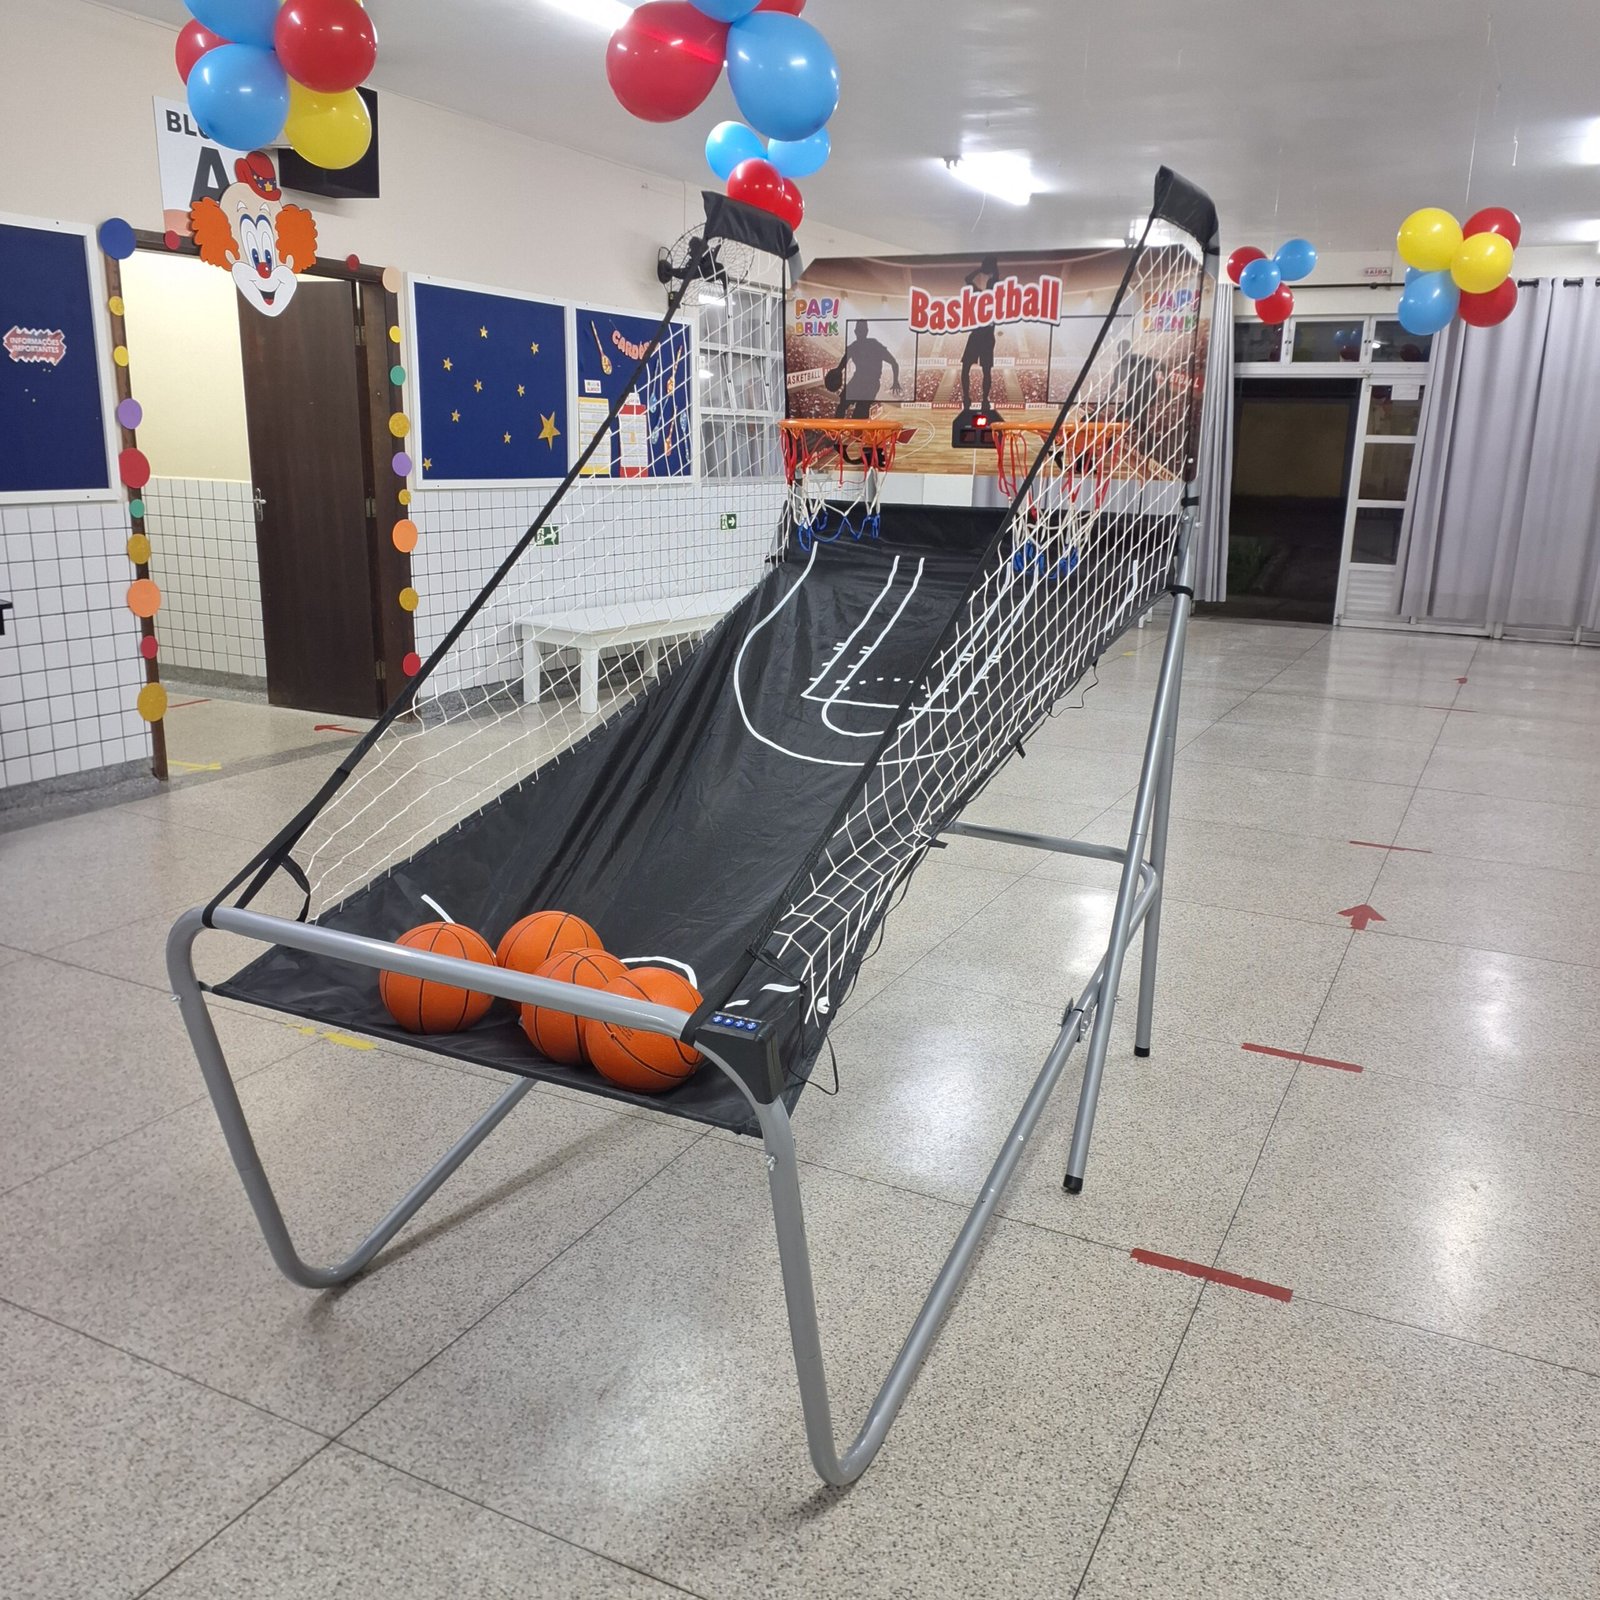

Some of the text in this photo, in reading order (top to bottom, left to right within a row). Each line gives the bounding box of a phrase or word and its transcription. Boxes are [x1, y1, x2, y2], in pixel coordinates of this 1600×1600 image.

[190, 146, 230, 208] A
[795, 298, 840, 318] PAPI
[910, 277, 1061, 331] Basketball
[796, 320, 839, 335] BRINK
[10, 337, 59, 347] INFORMAÇÕES
[12, 345, 60, 353] IMPORTANTES
[786, 372, 821, 385] ASKETBALL
